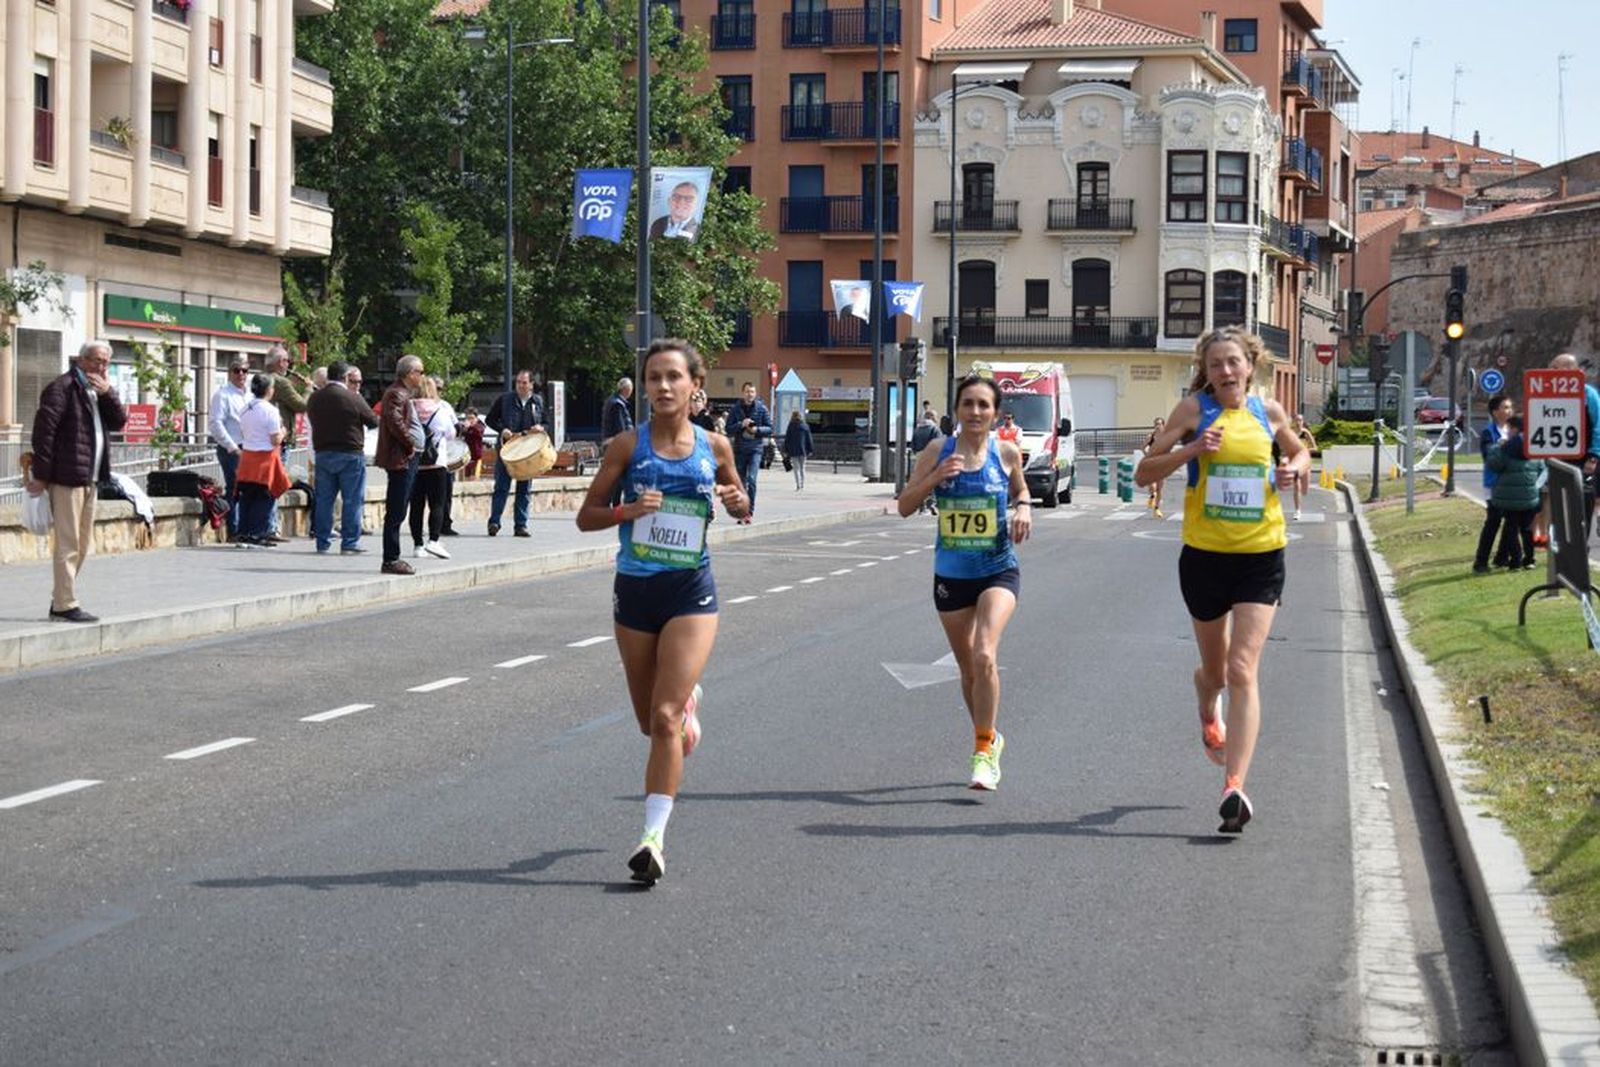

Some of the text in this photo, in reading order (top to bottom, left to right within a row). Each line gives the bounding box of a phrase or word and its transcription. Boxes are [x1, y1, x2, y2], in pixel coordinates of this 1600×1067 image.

[583, 185, 618, 197] VOTA
[1529, 377, 1580, 393] N-122
[1543, 405, 1566, 418] km
[1531, 426, 1578, 448] 459
[946, 513, 988, 534] 179
[648, 526, 688, 548] NOELIA
